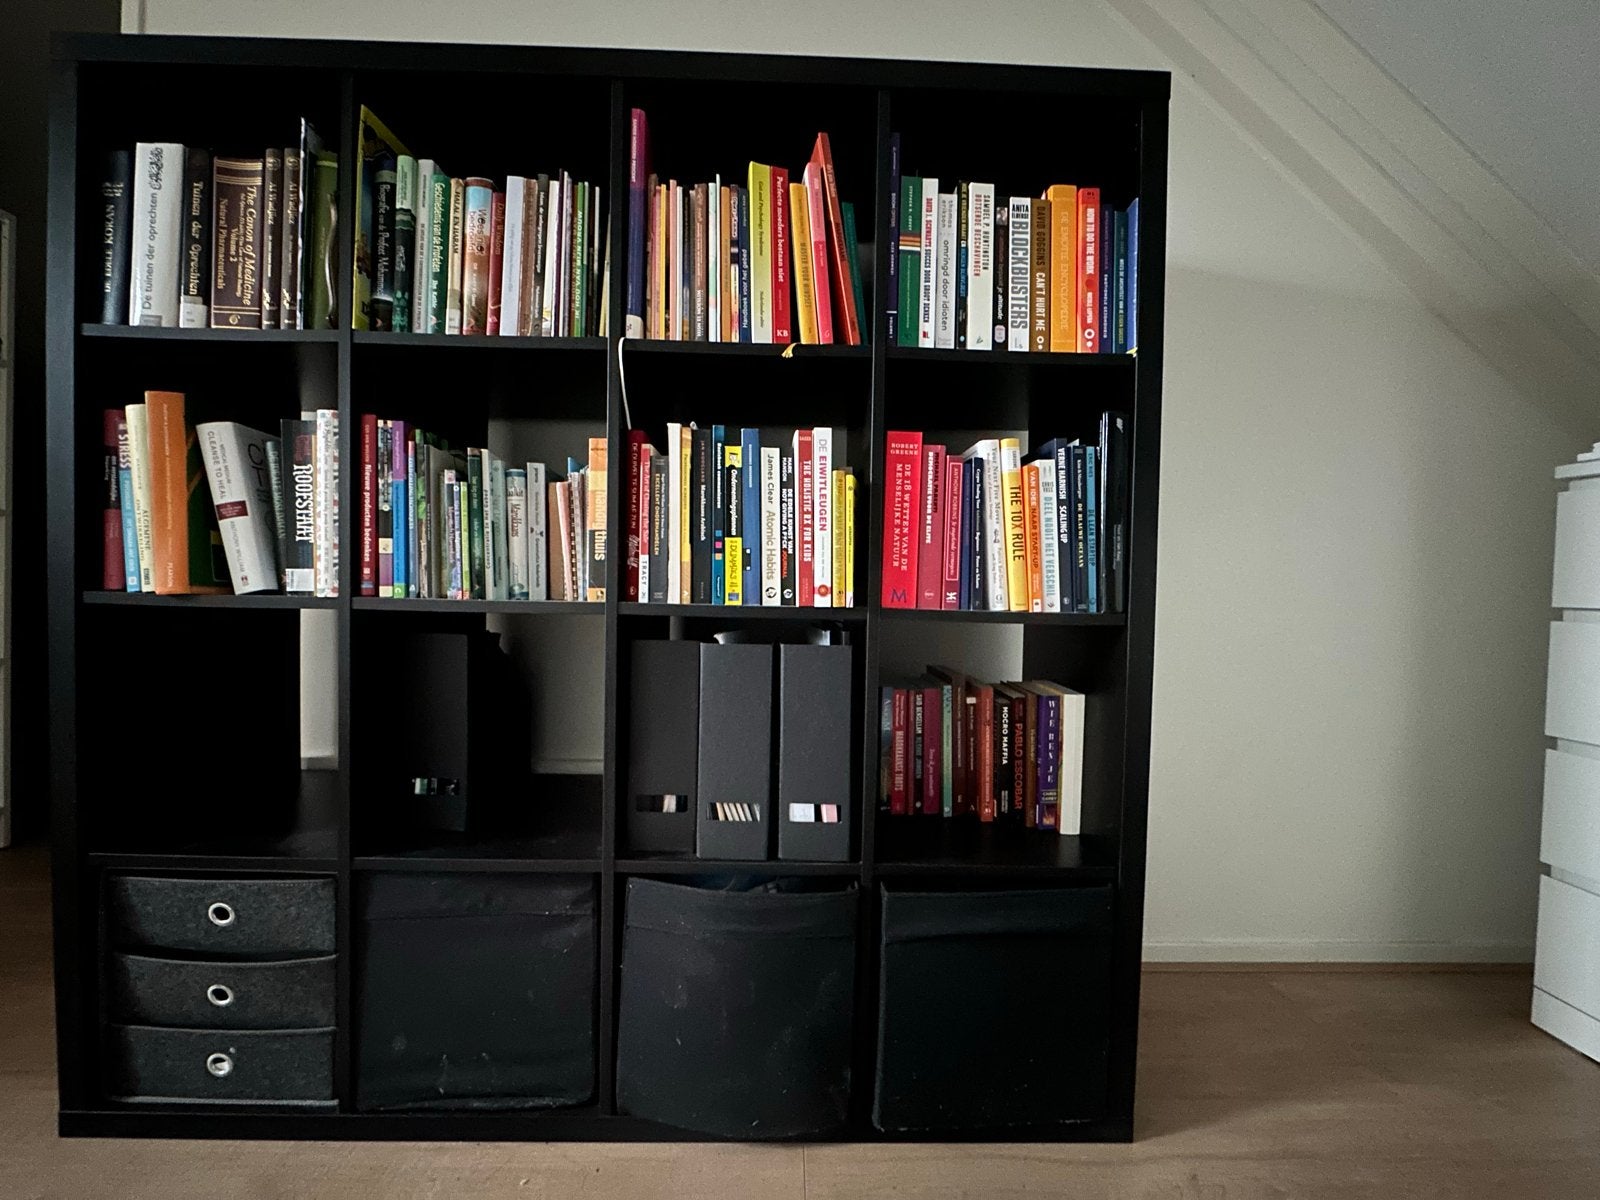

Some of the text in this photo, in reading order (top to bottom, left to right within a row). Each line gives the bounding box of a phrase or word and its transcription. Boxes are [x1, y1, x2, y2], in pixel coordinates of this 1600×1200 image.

[148, 193, 158, 241] oprechten
[453, 191, 461, 214] HALAL
[453, 216, 460, 227] EN
[477, 208, 487, 235] Wees
[495, 202, 504, 255] Daily Wisdom
[982, 194, 991, 220] SAMUEL
[1012, 204, 1029, 212] ANITA
[146, 244, 155, 260] der
[189, 181, 204, 295] Tuinen der Oprechten
[217, 198, 228, 290] Natural Pharmaceuticals
[230, 228, 239, 254] Volume
[242, 187, 257, 306] The Canon of Medicine
[741, 249, 749, 269] gebed
[973, 194, 982, 277] BOTSENDE BESCHAVINGEN
[982, 231, 990, 270] HUNTINGTON
[1086, 208, 1095, 275] HOW TO DO THE WORK
[144, 265, 153, 292] tuinen
[941, 239, 951, 331] omringd door idioten
[1010, 221, 1029, 329] BLOCKBUSTERS
[1036, 206, 1045, 331] DAVID GOGGINS CAN'T HURT ME
[1060, 211, 1069, 330] DE EMOTIE ENCYCLOPEDIE
[142, 296, 152, 310] De
[118, 434, 131, 468] STRESS
[207, 430, 226, 499] CLEANSE TO HEAL
[219, 443, 231, 484] MEDICAL MEDIUM
[818, 439, 828, 452] DE
[787, 488, 793, 497] DE
[818, 455, 828, 532] EIWITLEUGEN
[926, 451, 934, 494] DEMOCRATIE
[1029, 470, 1037, 487] VAN
[1030, 488, 1038, 506] IDEE
[1057, 447, 1068, 544] VERNE HARNISH SCALING UP
[292, 464, 314, 544] ROOFSTAAT
[363, 464, 372, 562] Nieuwe producten bedenken
[510, 503, 522, 538] Marokkaans
[591, 490, 607, 561] handig thuis
[729, 469, 738, 536] Ondernemingsplannen
[766, 454, 776, 580] James Clear Atomic Habits
[803, 460, 811, 562] THE HOLISTIC RX FOR KIDS
[892, 463, 903, 567] MENSELIJKE NATUUR
[900, 464, 912, 571] DE 18 WETTEN VAN DE
[925, 515, 932, 524] DE
[1010, 485, 1025, 562] THE 10X RULE
[1088, 509, 1094, 518] DE
[136, 499, 145, 562] ONTWIKKELING
[142, 509, 151, 550] ALGEMENE
[229, 520, 245, 572] ANTHONY WILLIAM
[1031, 531, 1039, 569] START-UP
[1043, 496, 1055, 597] DEEL NOOIT HET VERSCHIL
[1013, 722, 1024, 809] PABLO ESCOBAR
